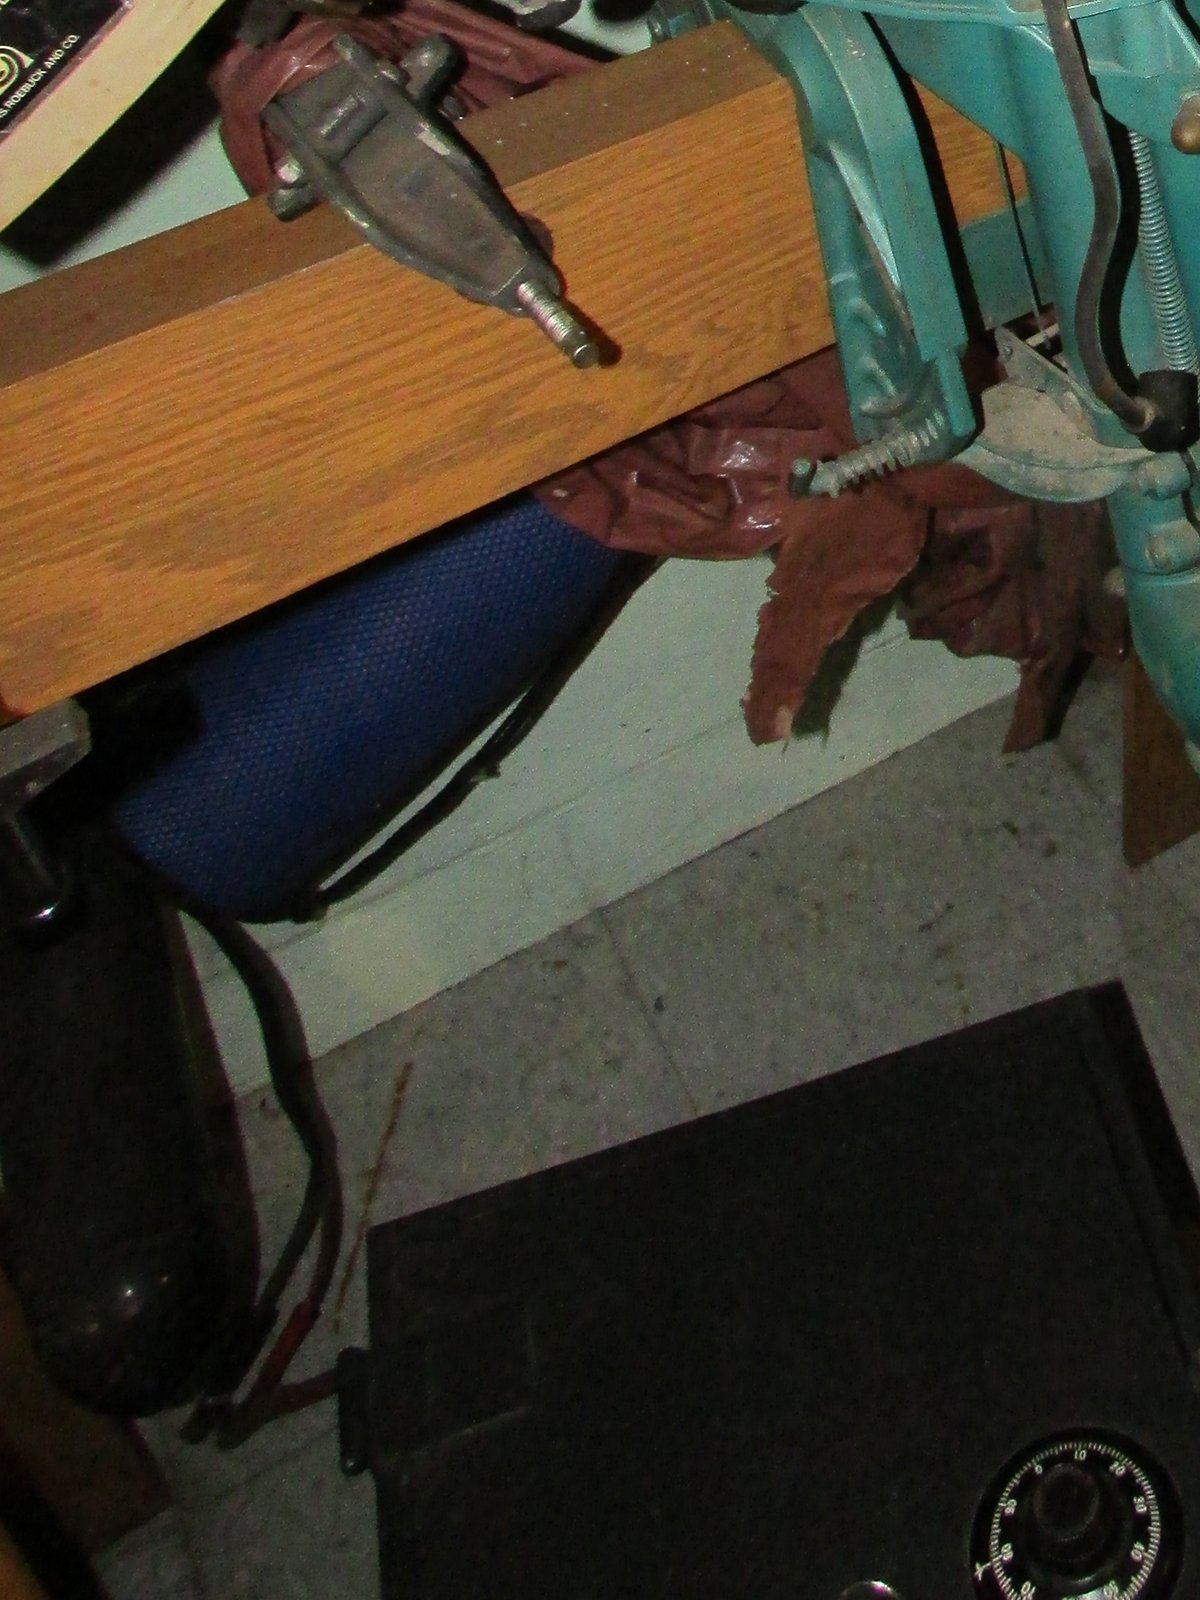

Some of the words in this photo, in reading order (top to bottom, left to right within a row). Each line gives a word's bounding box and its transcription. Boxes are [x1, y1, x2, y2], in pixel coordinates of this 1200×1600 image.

[5, 69, 47, 108] ROEBUCK
[44, 49, 65, 69] AND
[1074, 1450, 1087, 1461] 10
[1035, 1465, 1043, 1475] 0
[1109, 1461, 1126, 1476] 20
[1004, 1499, 1017, 1514] 90
[1133, 1497, 1147, 1513] 30
[1002, 1543, 1013, 1560] 80
[1131, 1542, 1145, 1561] 40
